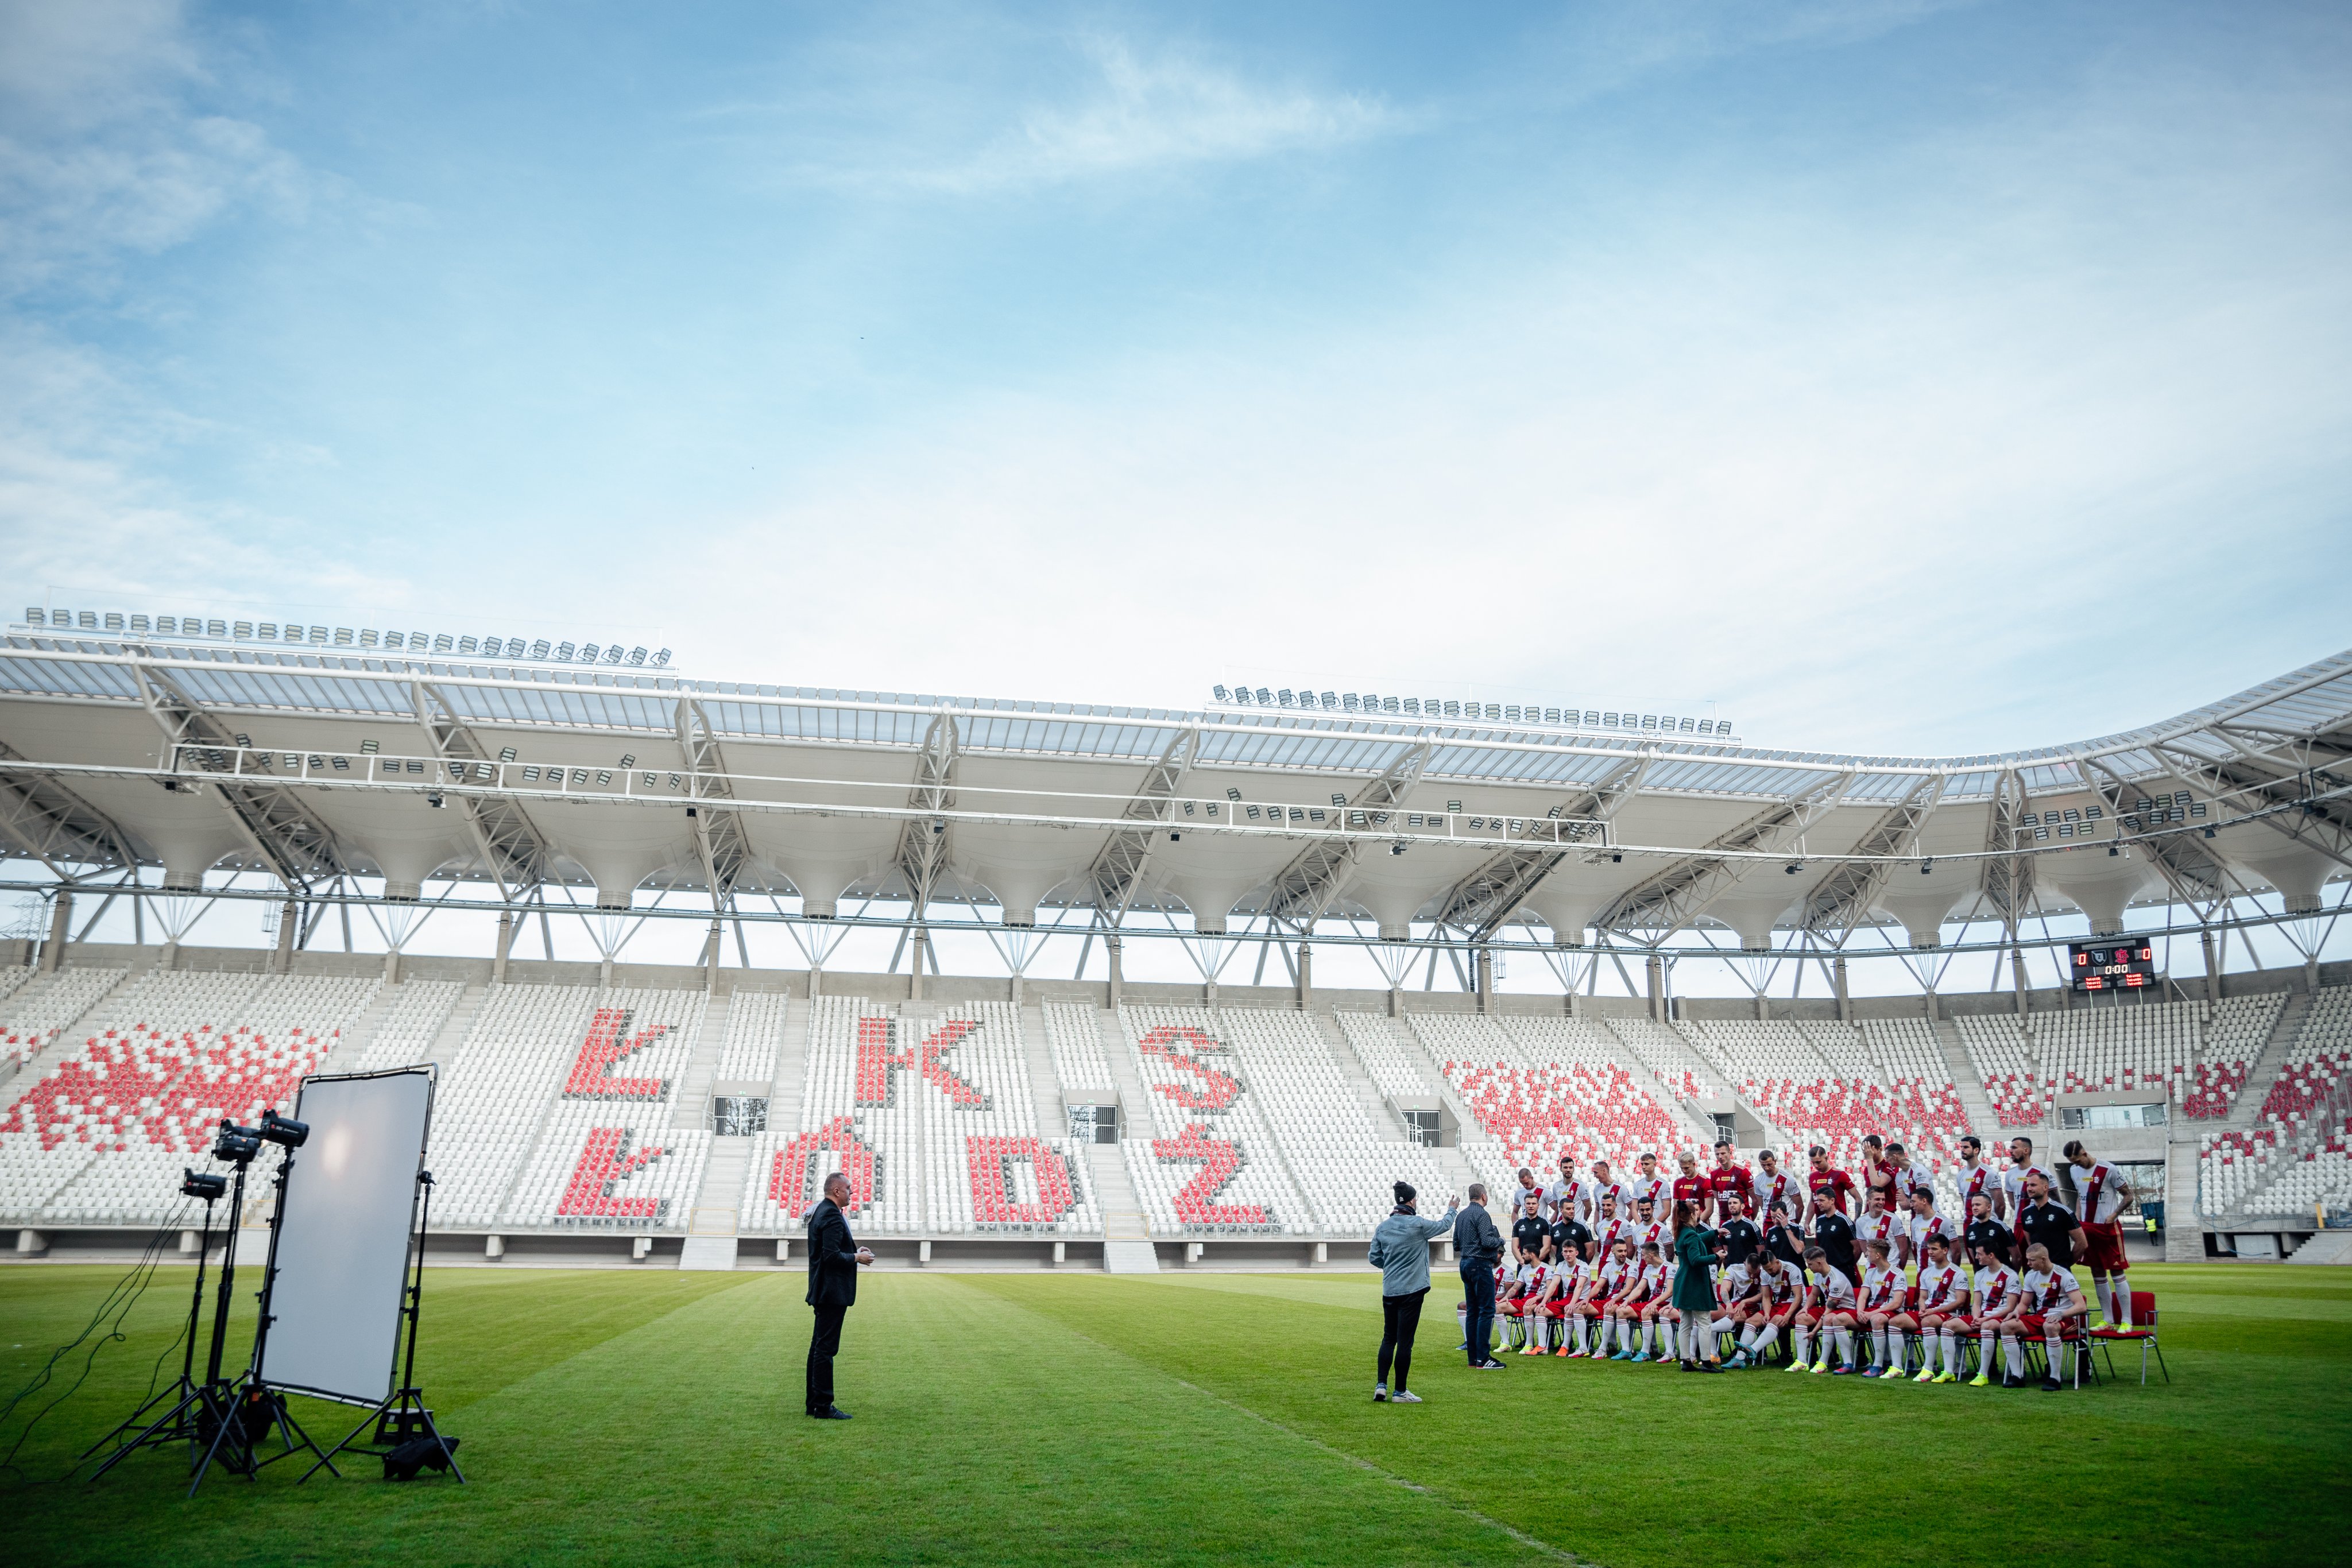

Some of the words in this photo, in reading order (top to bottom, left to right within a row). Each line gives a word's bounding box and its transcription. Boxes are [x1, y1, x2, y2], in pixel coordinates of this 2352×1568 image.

[2078, 954, 2086, 965] 0
[2142, 948, 2150, 960] 0
[2105, 964, 2128, 975] 0:00
